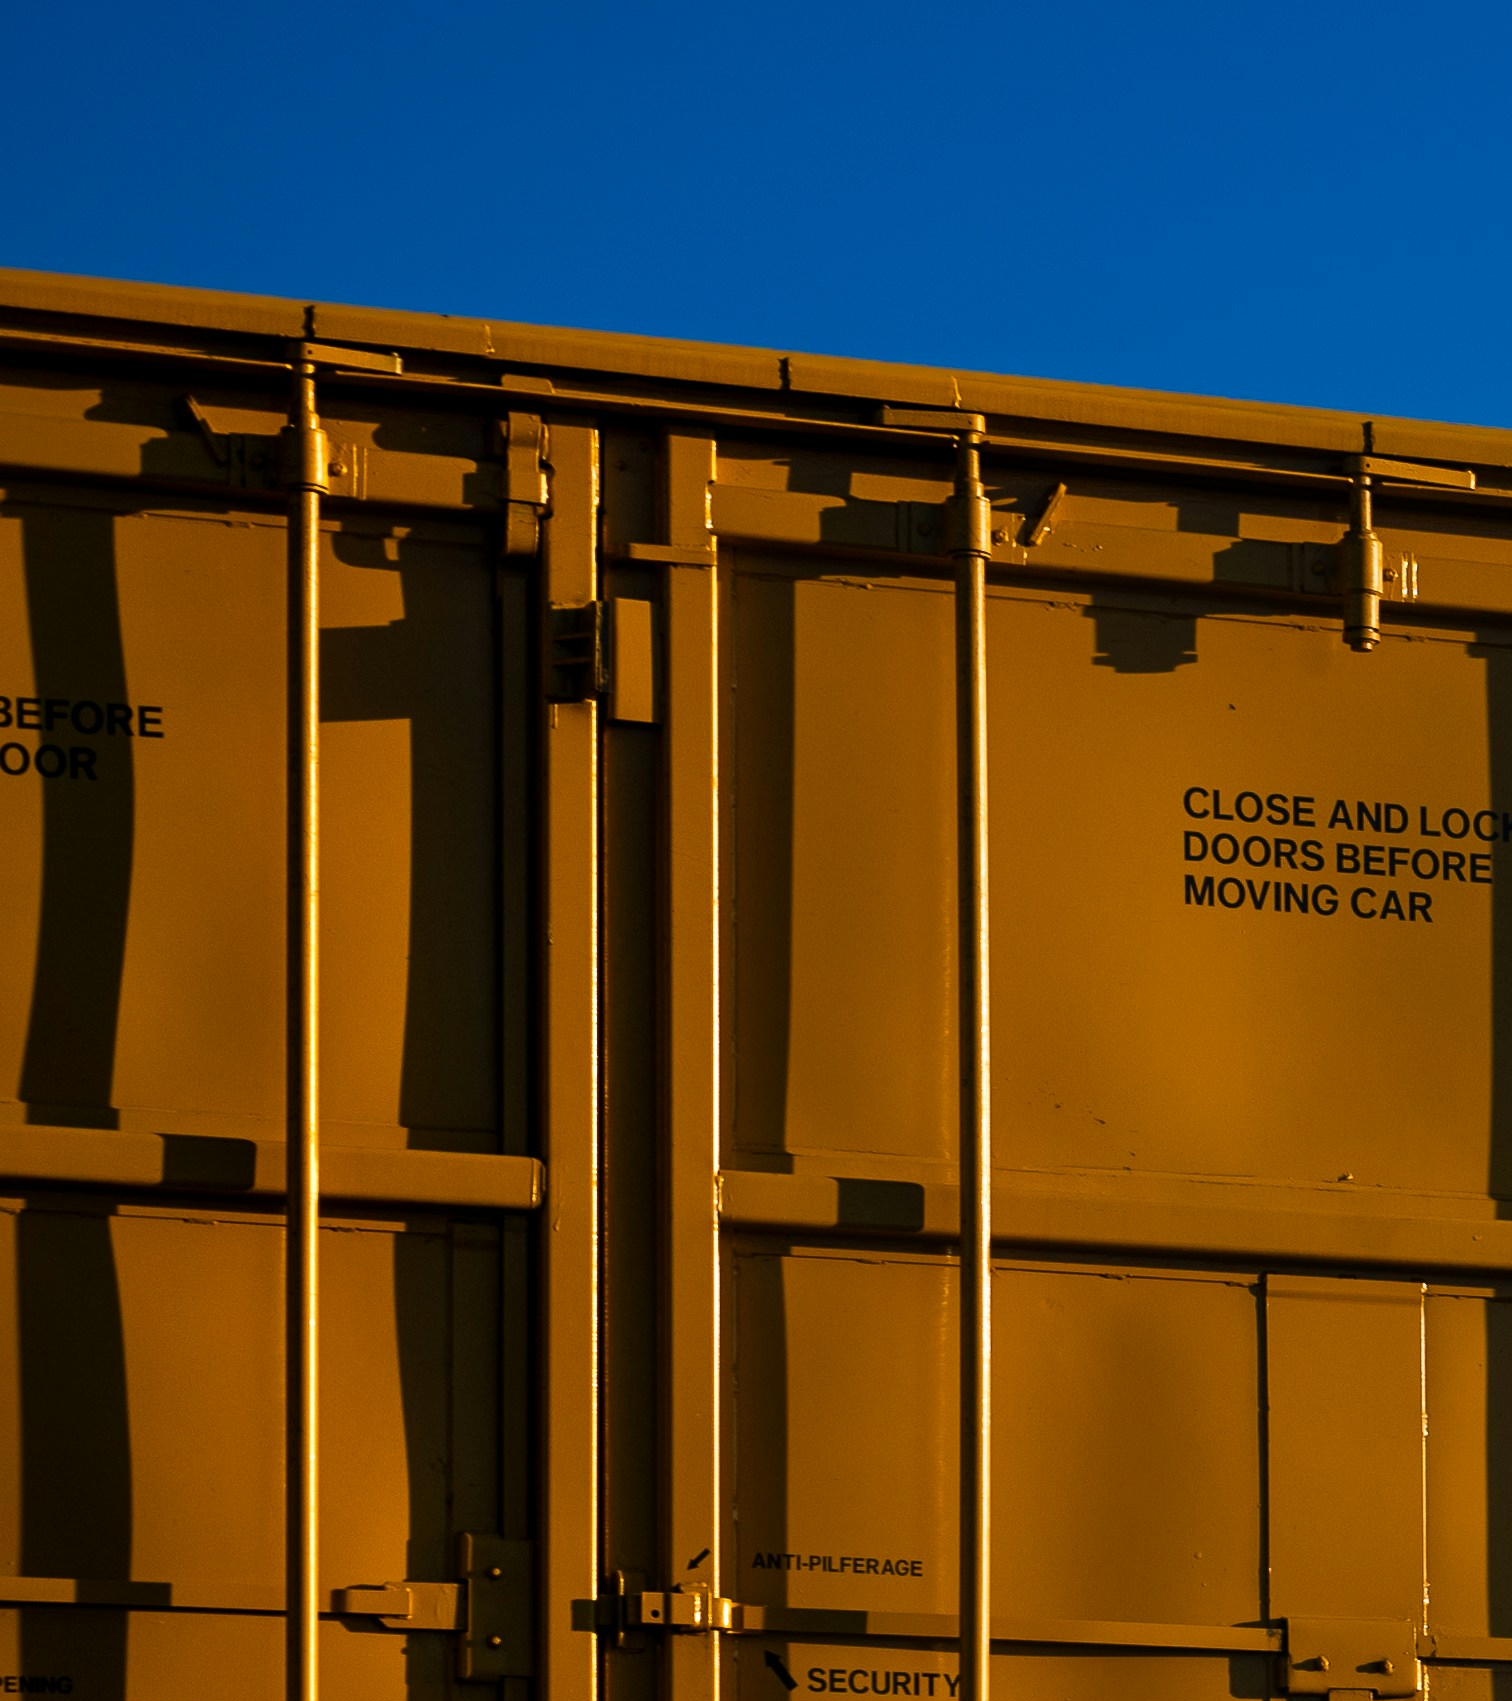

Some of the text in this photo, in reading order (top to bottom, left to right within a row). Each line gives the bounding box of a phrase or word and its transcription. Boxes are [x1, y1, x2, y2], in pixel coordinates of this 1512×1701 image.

[0, 696, 164, 738] BEFORE
[0, 742, 97, 780] OOR
[1183, 787, 1316, 827] CLOSE
[1328, 799, 1409, 834] AND
[1183, 830, 1493, 884] DOORS BEFORE
[1183, 874, 1433, 923] MOVING CAR
[751, 1553, 923, 1577] ANTI-PILFERAGE
[0, 1676, 73, 1694] ENING
[807, 1667, 960, 1697] SECURITY
